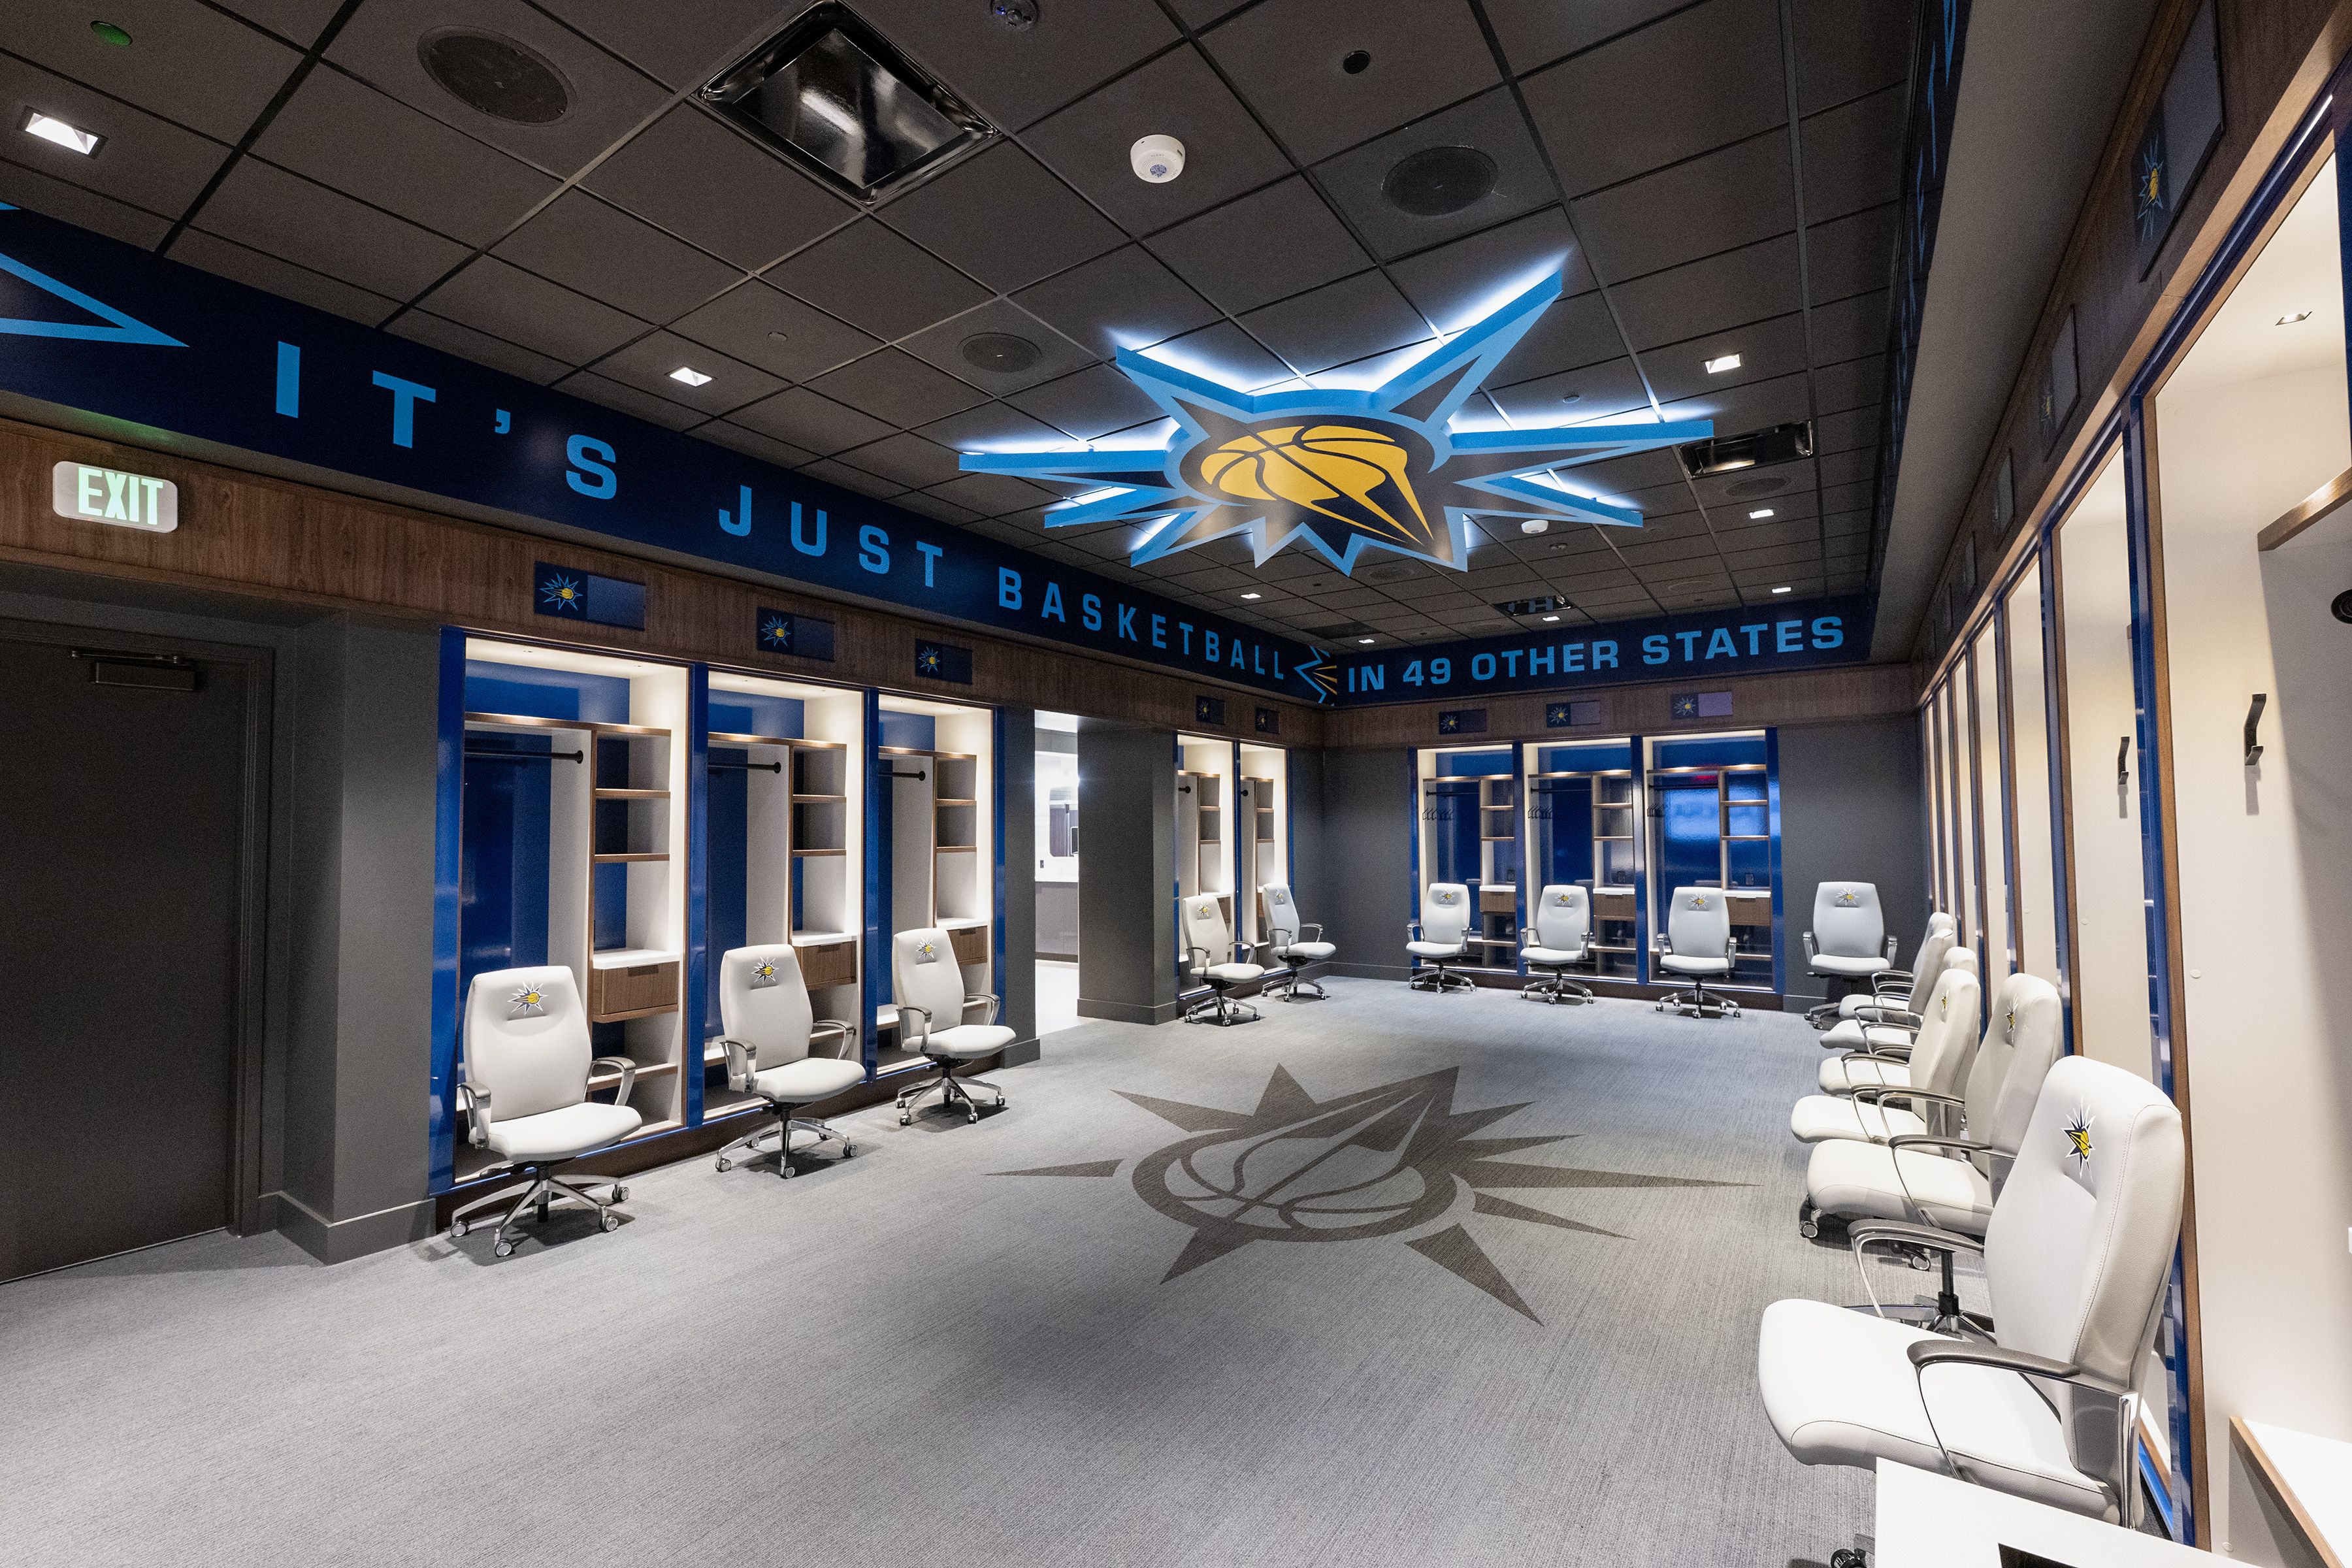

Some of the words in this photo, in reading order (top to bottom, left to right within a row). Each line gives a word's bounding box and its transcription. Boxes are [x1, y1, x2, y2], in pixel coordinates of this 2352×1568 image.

[78, 466, 164, 525] EXIT
[276, 341, 618, 500] IT'S
[719, 485, 943, 588] JUST
[998, 566, 1284, 680] BASKETBALL
[1348, 664, 1384, 693] IN
[1403, 658, 1451, 686] 49
[1471, 640, 1619, 680] OTHER
[1642, 616, 1844, 665] STATES
